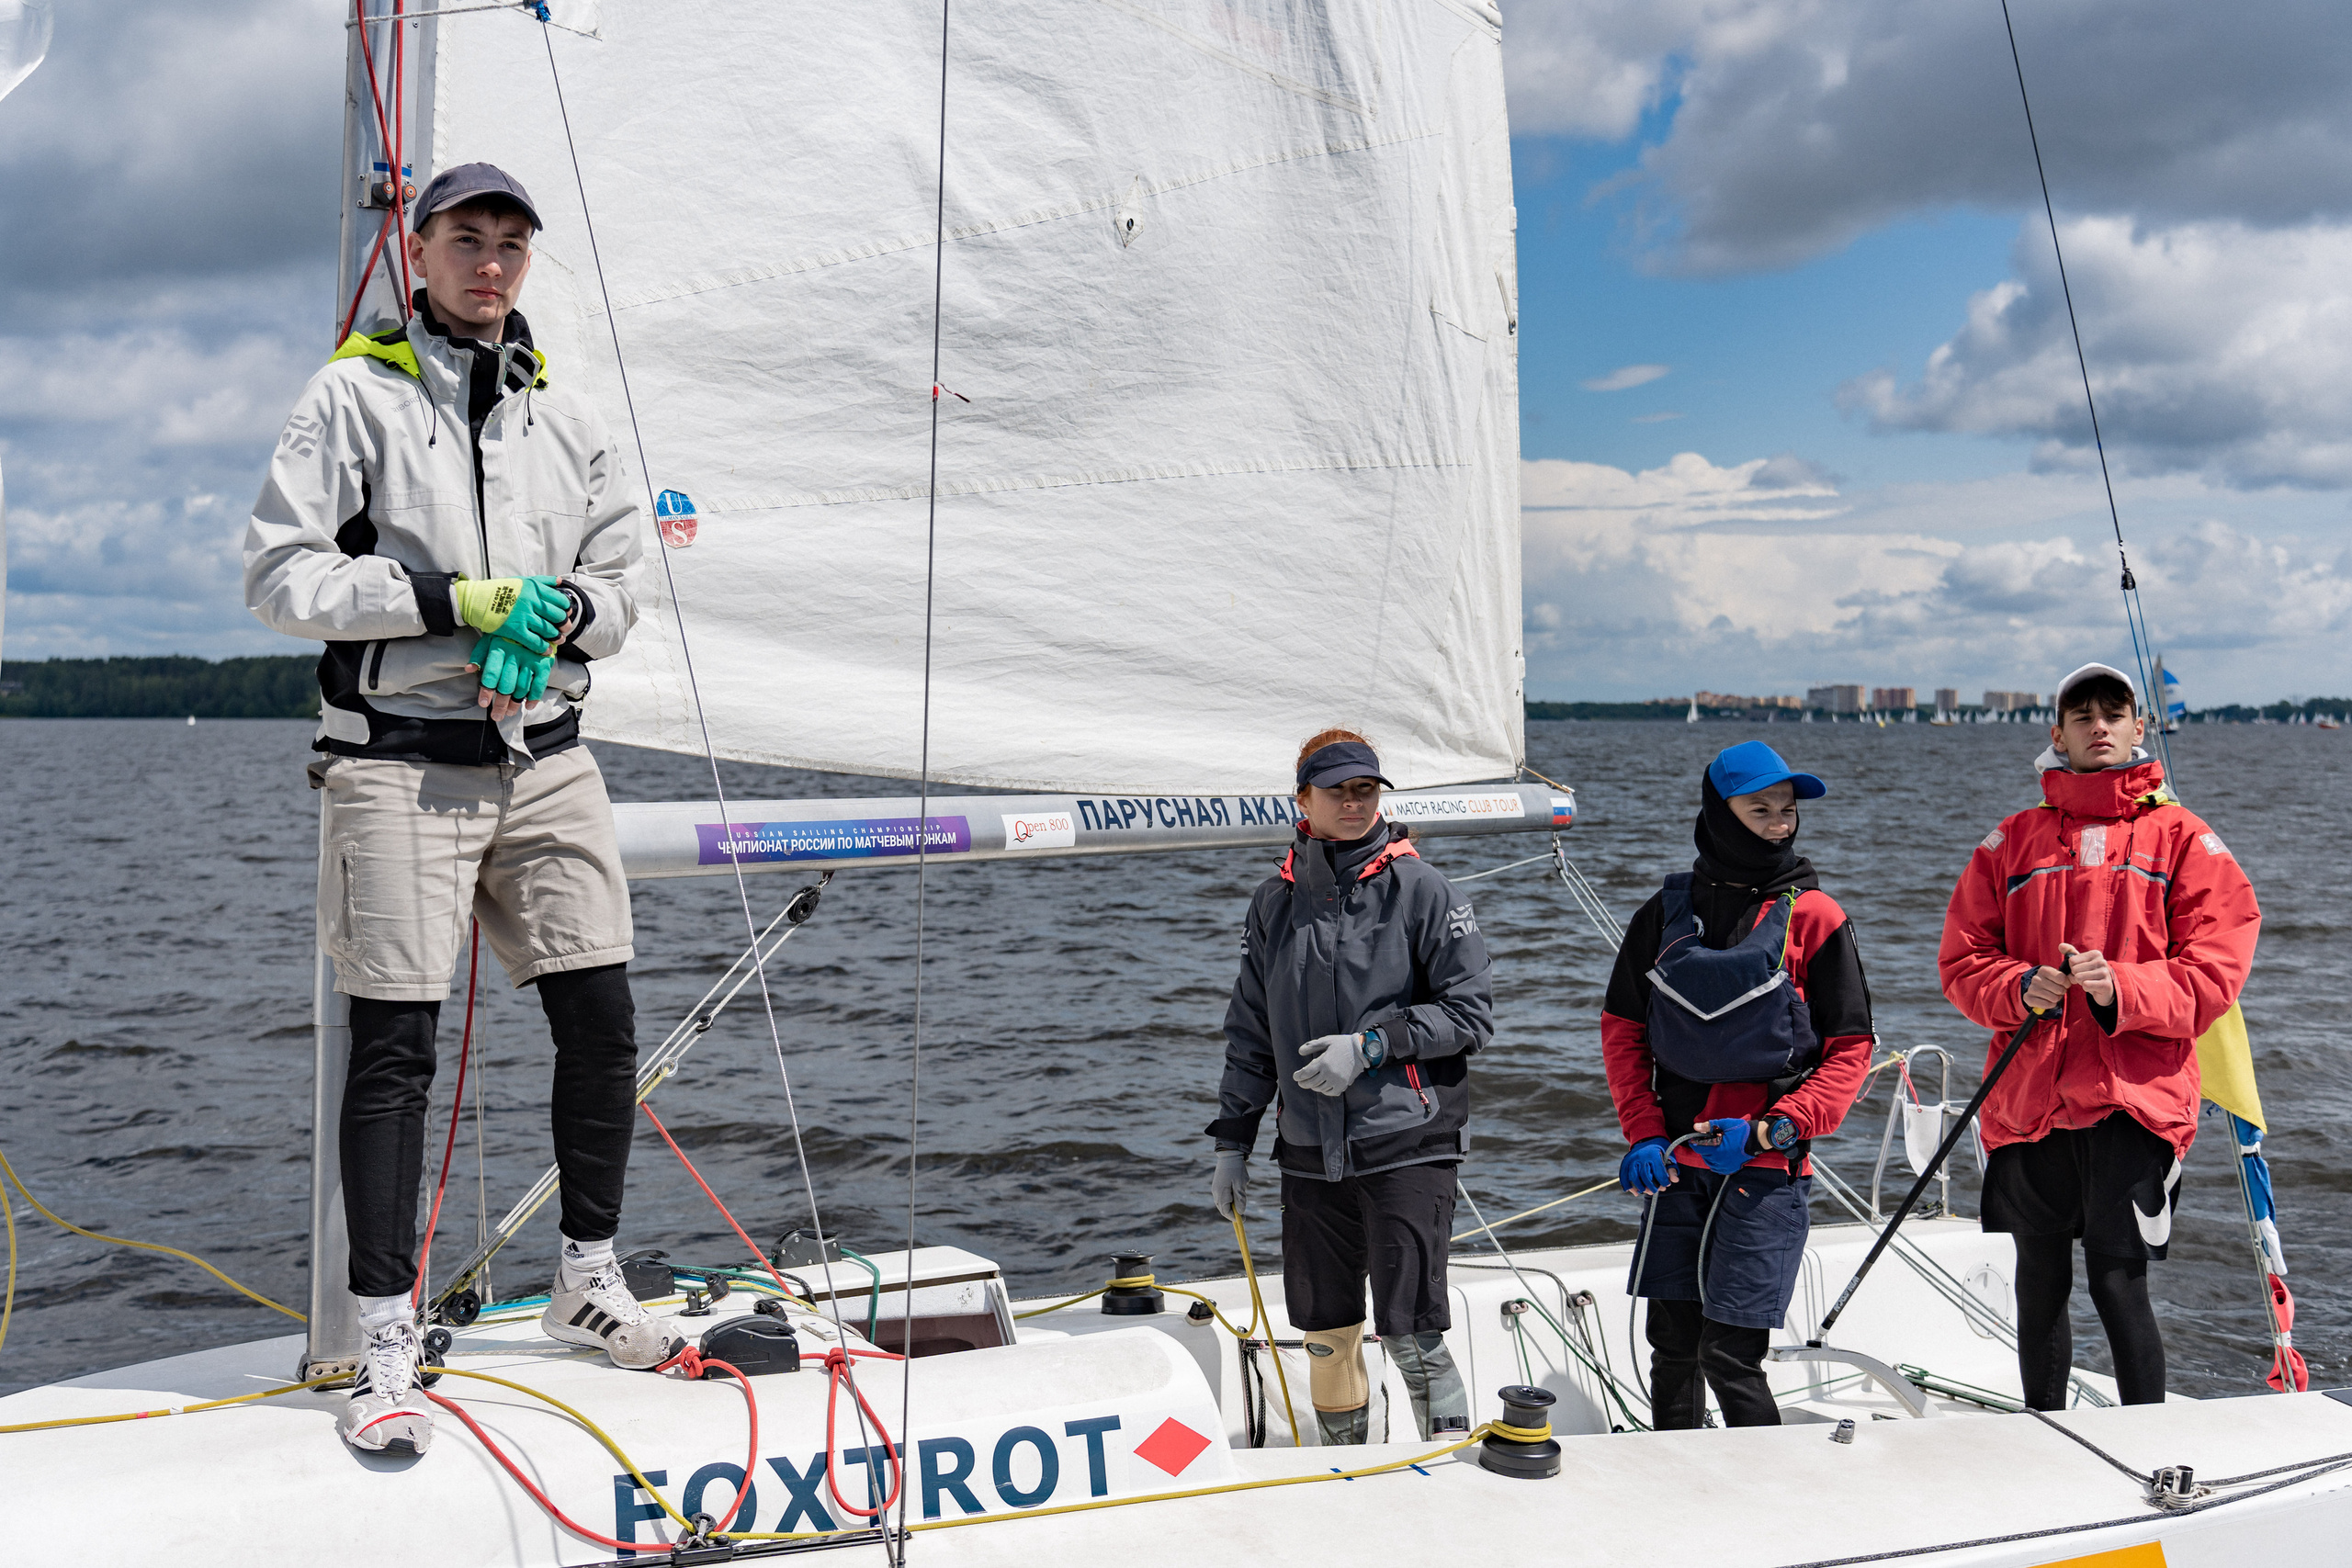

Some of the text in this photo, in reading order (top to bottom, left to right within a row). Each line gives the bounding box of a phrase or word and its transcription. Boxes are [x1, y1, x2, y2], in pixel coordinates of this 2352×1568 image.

[663, 492, 682, 514] U
[672, 521, 688, 545] S
[1077, 797, 1230, 830] ПАРУСНАЯ
[1396, 798, 1520, 816] MATCH RACING CLUB TOUR
[793, 829, 843, 837] SAILING
[1049, 818, 1069, 830] 800
[718, 832, 956, 854] ЧЕМПИОНАТ РОССИИ ПО МАТЧЕВЫМ ГОНКАМ
[614, 1415, 1122, 1560] FOXTROT
